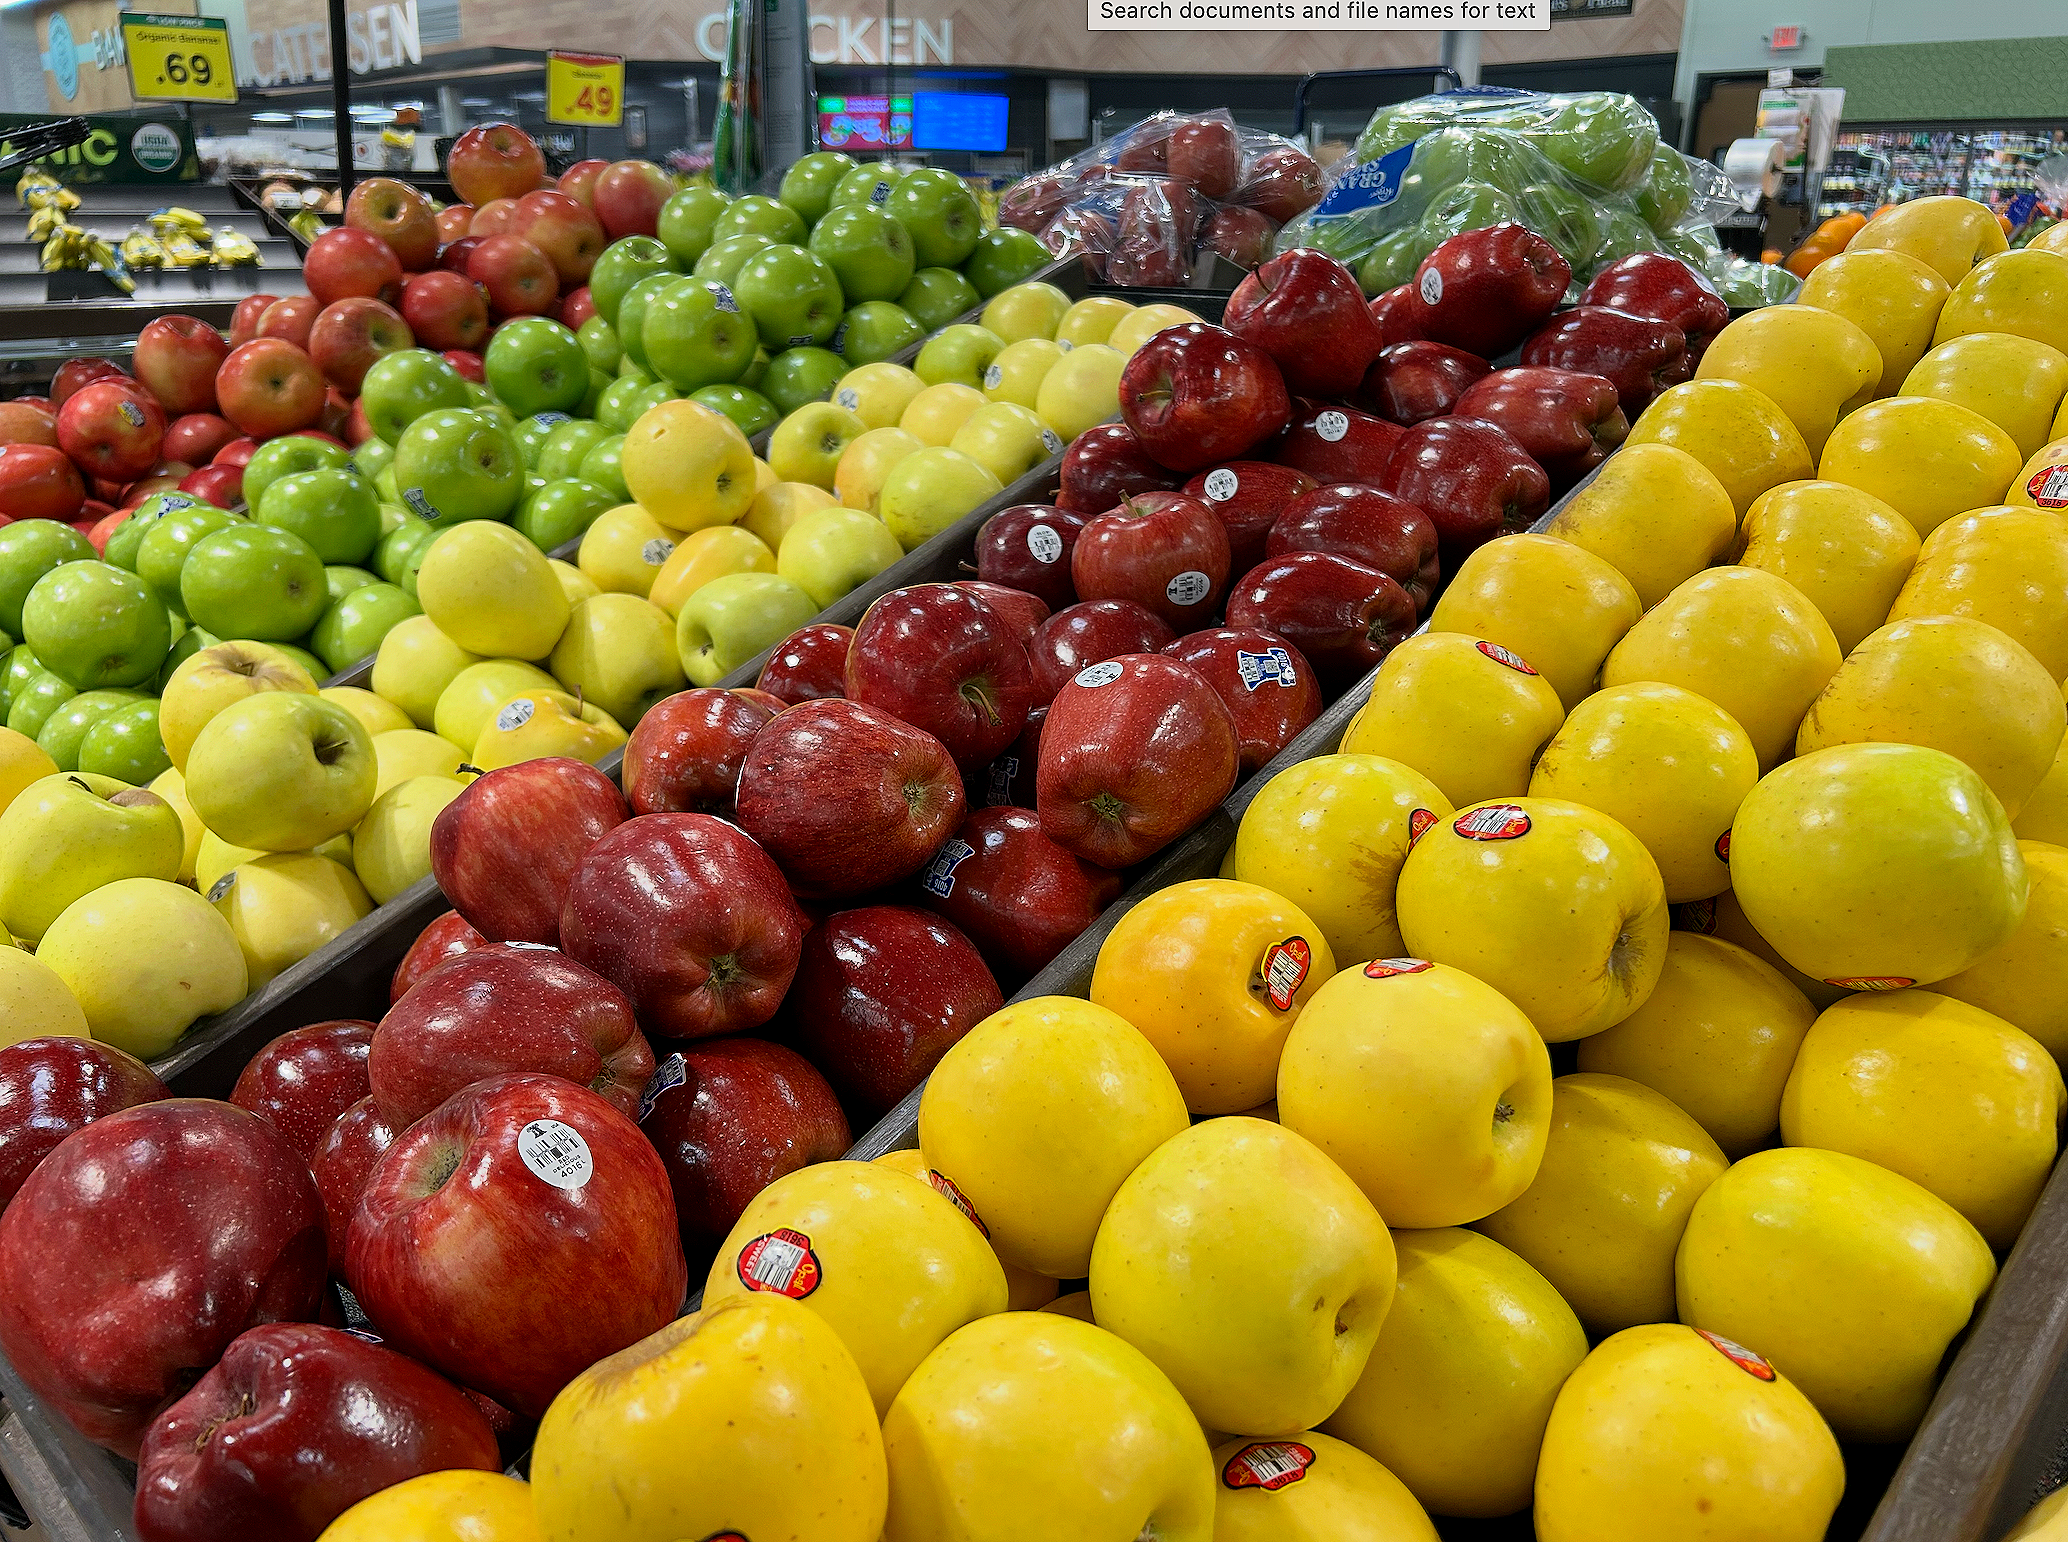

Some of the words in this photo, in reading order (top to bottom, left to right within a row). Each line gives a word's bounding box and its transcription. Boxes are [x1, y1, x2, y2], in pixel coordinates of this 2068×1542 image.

[136, 31, 176, 43] Organic
[178, 33, 220, 45] Bananas
[695, 13, 953, 65] CCKEN
[155, 52, 213, 86] .69
[564, 84, 614, 117] .49
[552, 1154, 581, 1174] DELICIOUS
[557, 1155, 571, 1165] RED
[561, 1160, 583, 1178] 4016
[779, 1230, 804, 1246] 3618
[743, 1239, 767, 1276] SWEET
[792, 1263, 815, 1292] Opal
[1271, 1471, 1299, 1487] 3618
